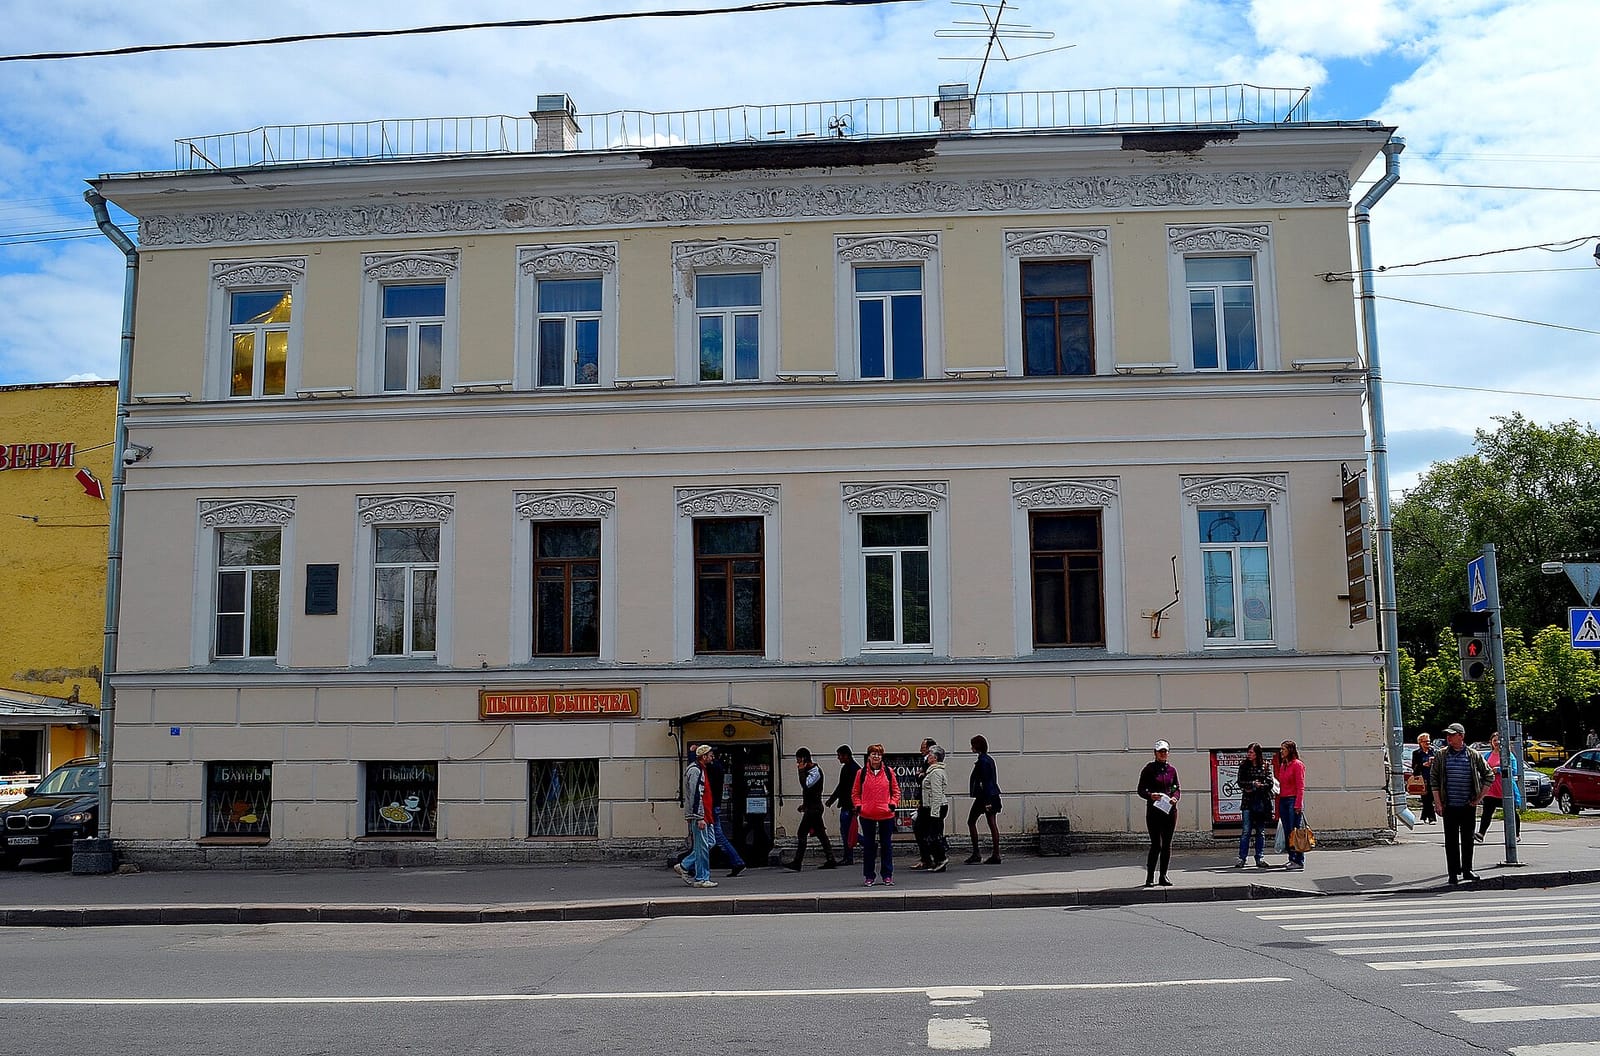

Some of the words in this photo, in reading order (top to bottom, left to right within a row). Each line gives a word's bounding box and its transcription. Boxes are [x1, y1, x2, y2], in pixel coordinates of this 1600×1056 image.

[486, 695, 550, 715] ПЫШКИ
[554, 693, 632, 714] ВЫПЕЧКА
[834, 687, 910, 711] ЦАРСТВО
[916, 686, 980, 707] ТОРТОВ
